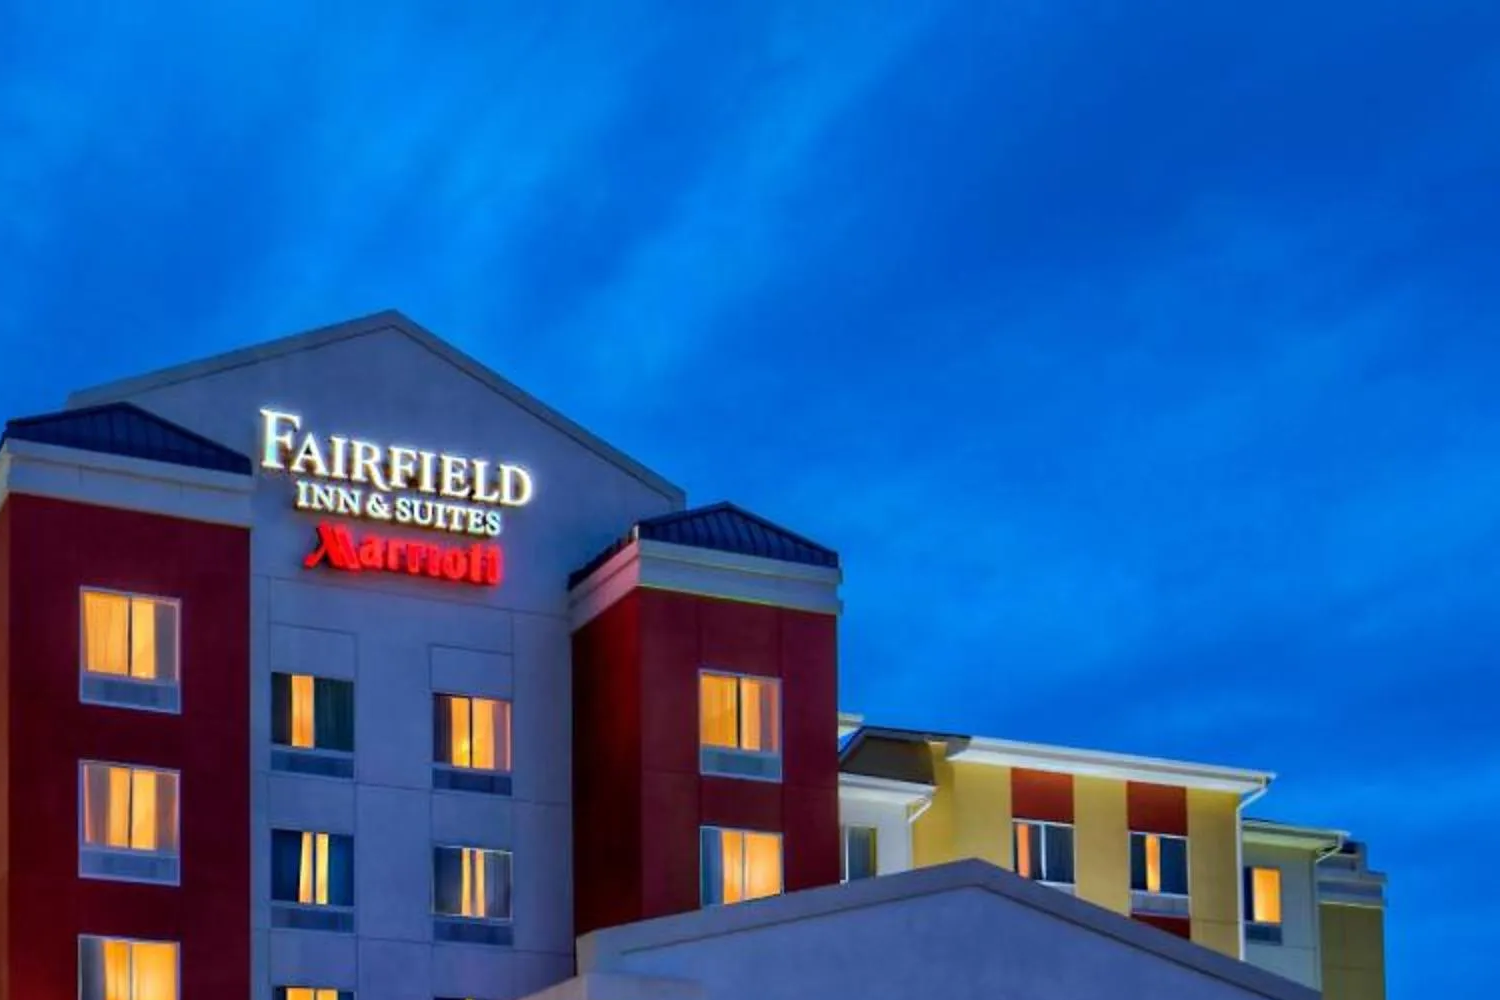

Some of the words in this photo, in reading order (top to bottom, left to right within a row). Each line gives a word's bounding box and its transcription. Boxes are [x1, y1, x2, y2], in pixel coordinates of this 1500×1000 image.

[259, 408, 532, 507] FAIRFIELD
[297, 480, 361, 515] INN
[366, 492, 392, 520] &
[395, 497, 501, 537] SUITES
[304, 520, 503, 585] Marriott
